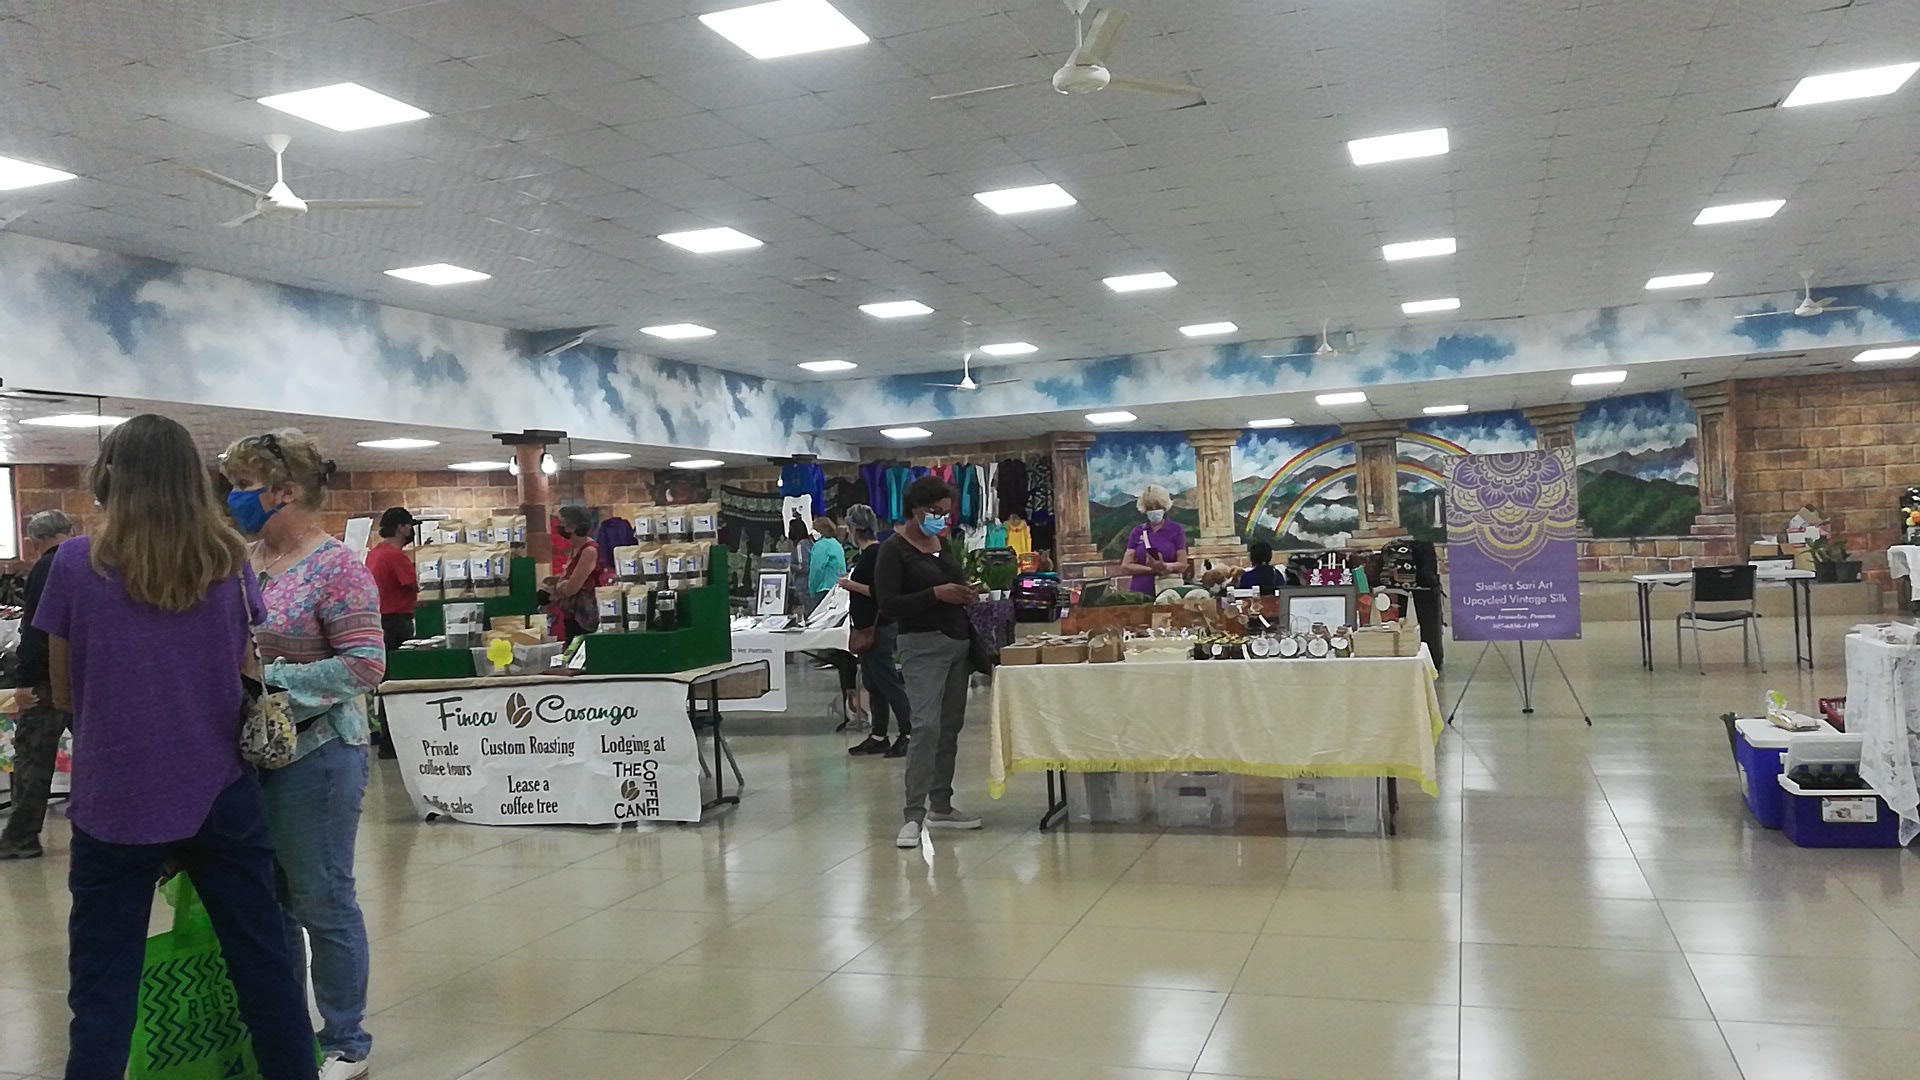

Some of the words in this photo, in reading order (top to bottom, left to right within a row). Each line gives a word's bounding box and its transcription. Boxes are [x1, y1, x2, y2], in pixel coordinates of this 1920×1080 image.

[1475, 582, 1514, 592] Shellie's
[1516, 581, 1536, 591] Sari
[1538, 580, 1553, 590] Art
[1462, 595, 1508, 606] Upcycled
[1509, 595, 1547, 606] Vintage
[1550, 593, 1568, 603] Silk
[425, 696, 498, 731] Finca
[535, 694, 639, 726] Casanga
[421, 740, 460, 757] Private
[481, 737, 526, 756] Custom
[528, 735, 576, 758] Roasting
[600, 734, 651, 756] Lodging
[653, 736, 667, 752] at
[418, 759, 446, 776] coffee
[446, 762, 473, 777] tours
[612, 761, 642, 778] THE
[506, 774, 541, 793] Lease
[542, 779, 550, 792] a
[450, 796, 474, 814] sales
[500, 795, 535, 815] coffee
[536, 798, 559, 814] tree
